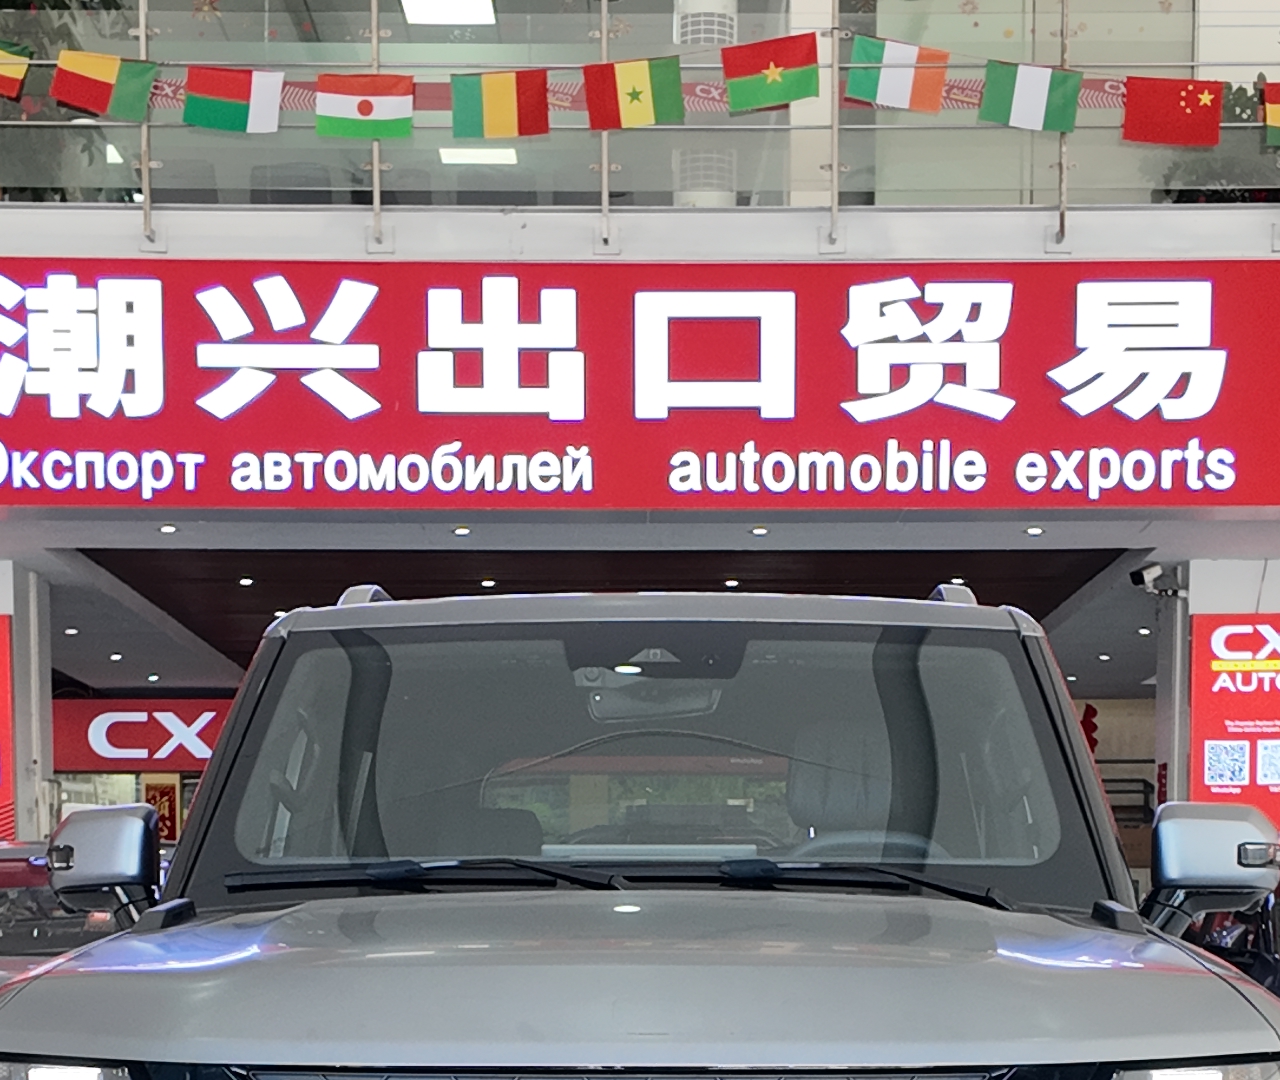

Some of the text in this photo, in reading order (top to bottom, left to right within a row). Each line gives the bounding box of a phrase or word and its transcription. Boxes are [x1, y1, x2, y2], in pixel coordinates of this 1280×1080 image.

[695, 85, 723, 99] CX
[951, 88, 981, 100] AUTO
[230, 441, 595, 494] автомобилей
[667, 440, 1238, 500] automobile exports
[87, 711, 217, 759] CX
